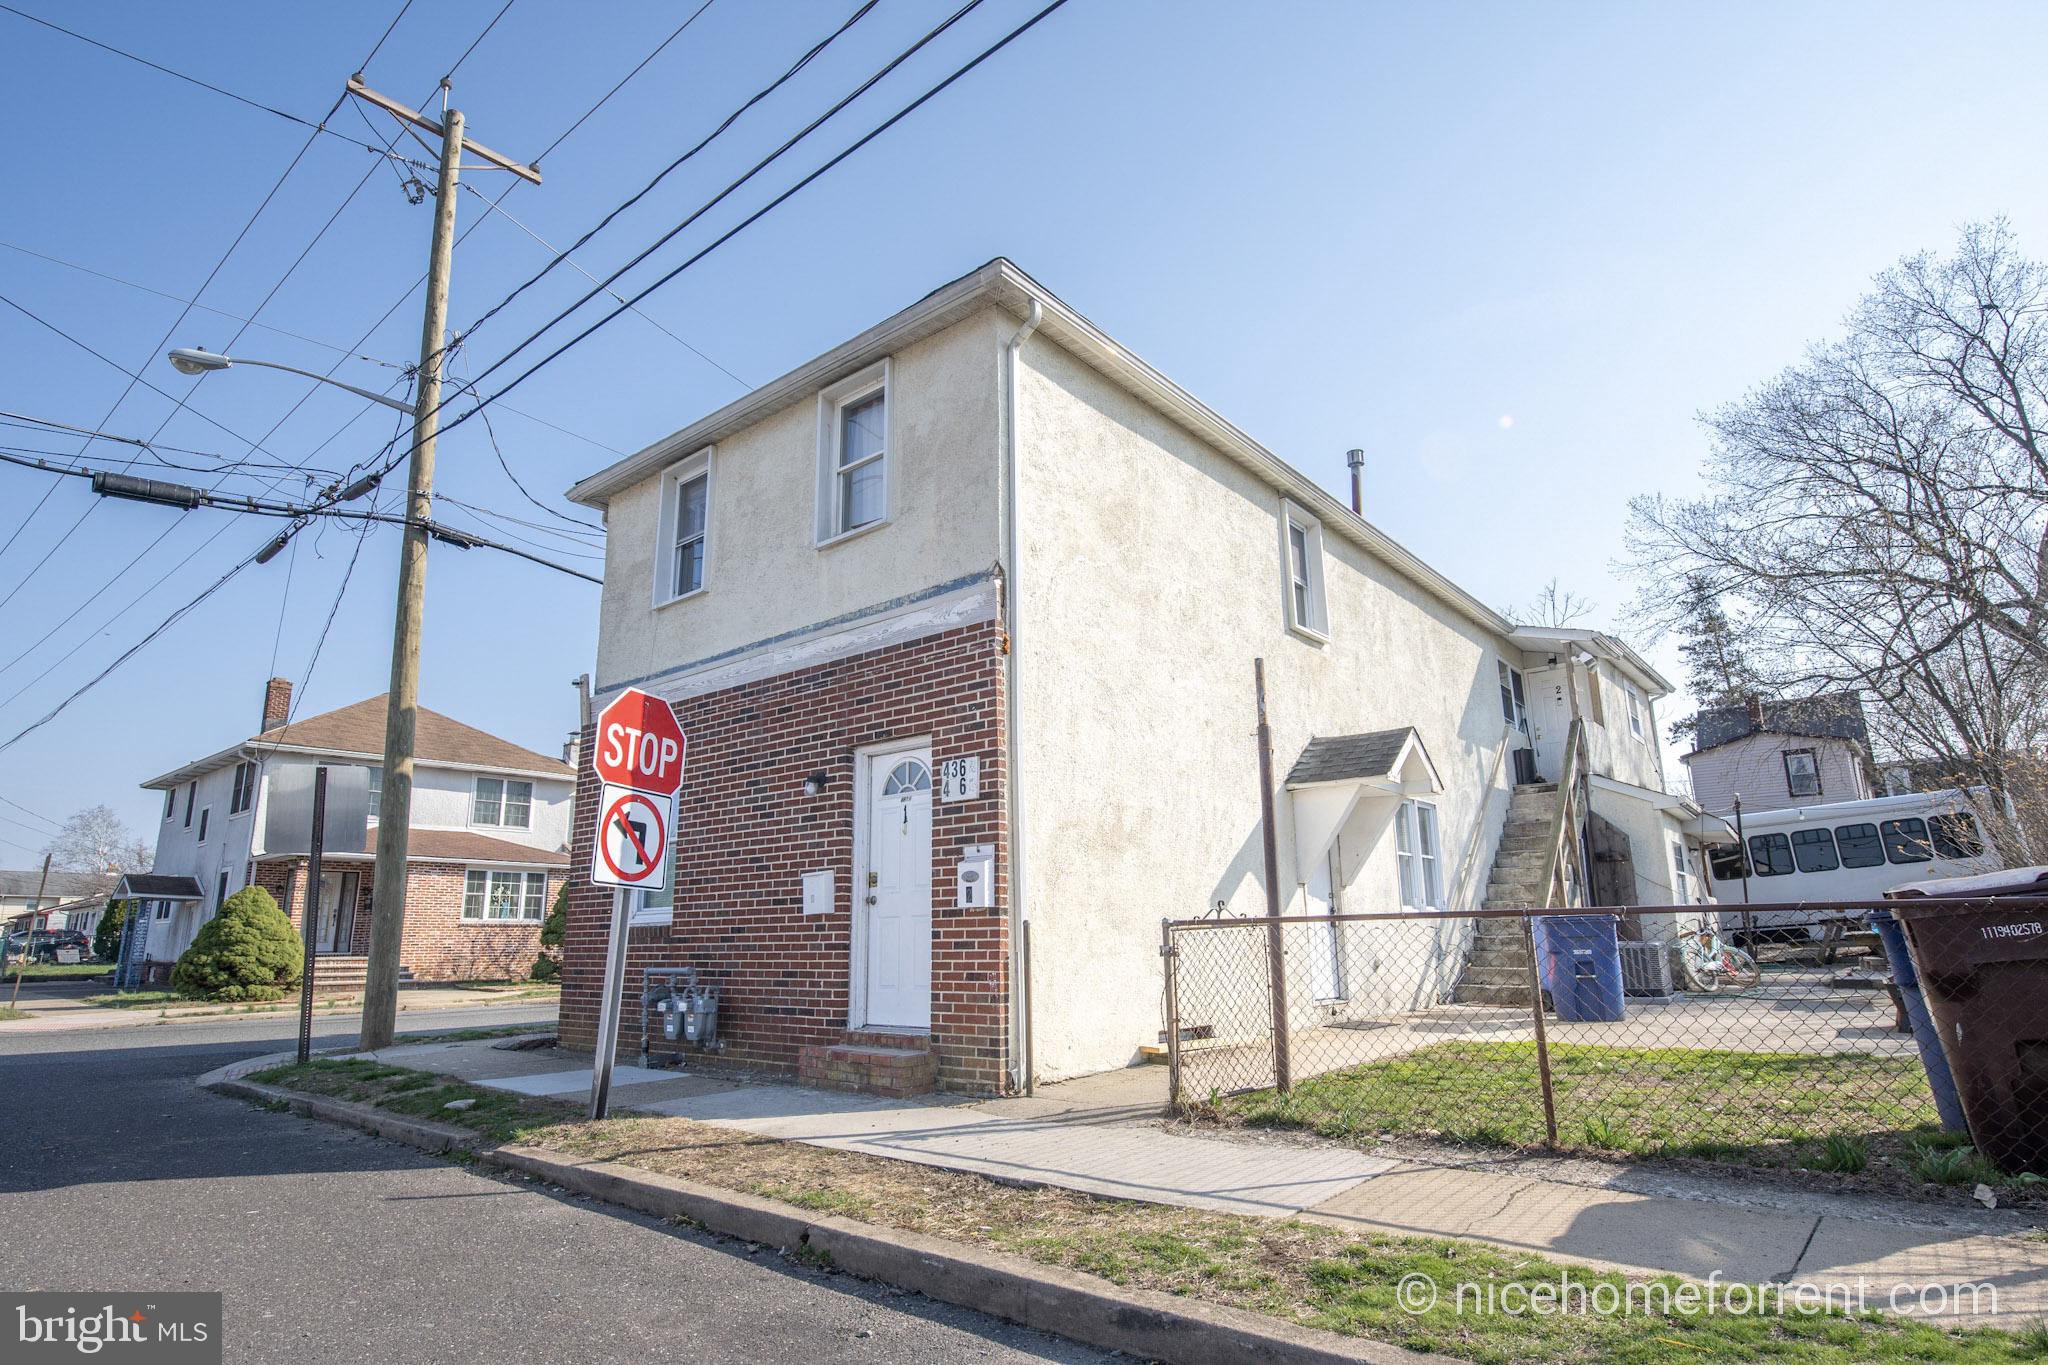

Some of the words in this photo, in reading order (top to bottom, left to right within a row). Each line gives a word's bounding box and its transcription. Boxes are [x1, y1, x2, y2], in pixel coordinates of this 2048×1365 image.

[1555, 685, 1562, 695] 2
[604, 722, 678, 778] STOP
[943, 759, 966, 779] 436
[1981, 922, 2043, 939] 1119402578
